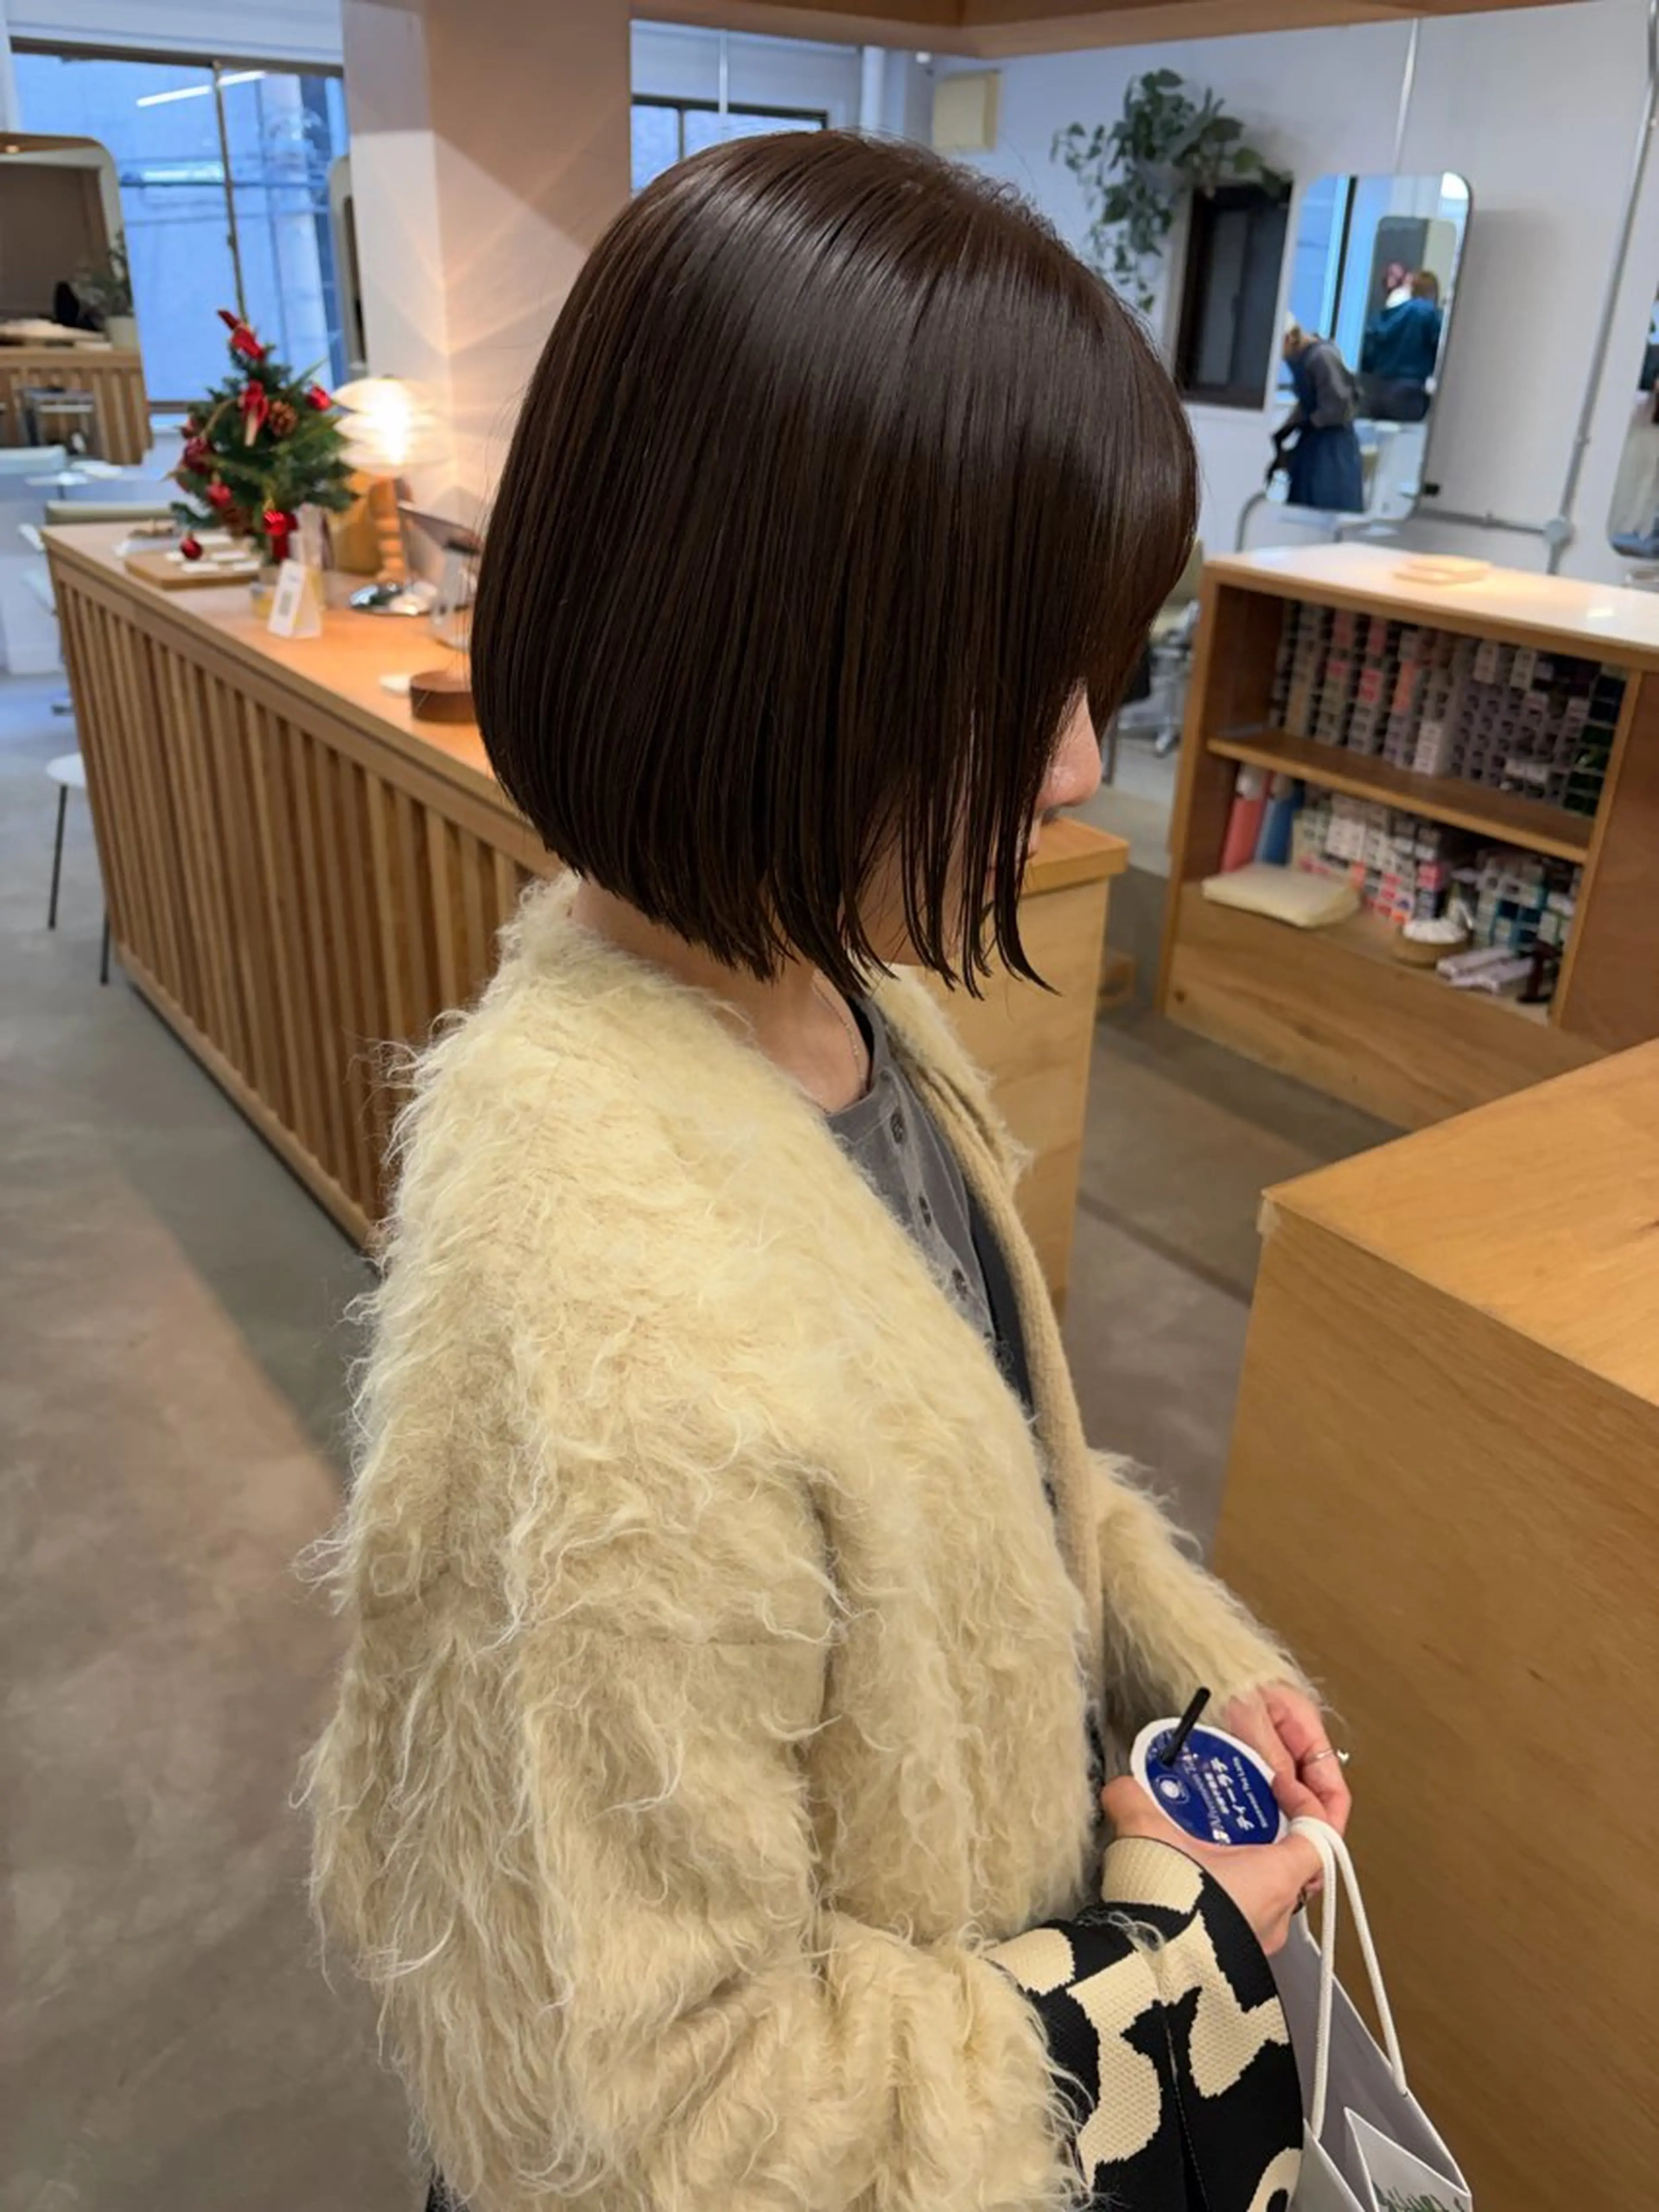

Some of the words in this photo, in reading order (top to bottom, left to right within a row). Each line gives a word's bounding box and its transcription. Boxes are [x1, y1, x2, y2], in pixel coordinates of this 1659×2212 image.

[1210, 1757, 1255, 1830] ティーラテ
